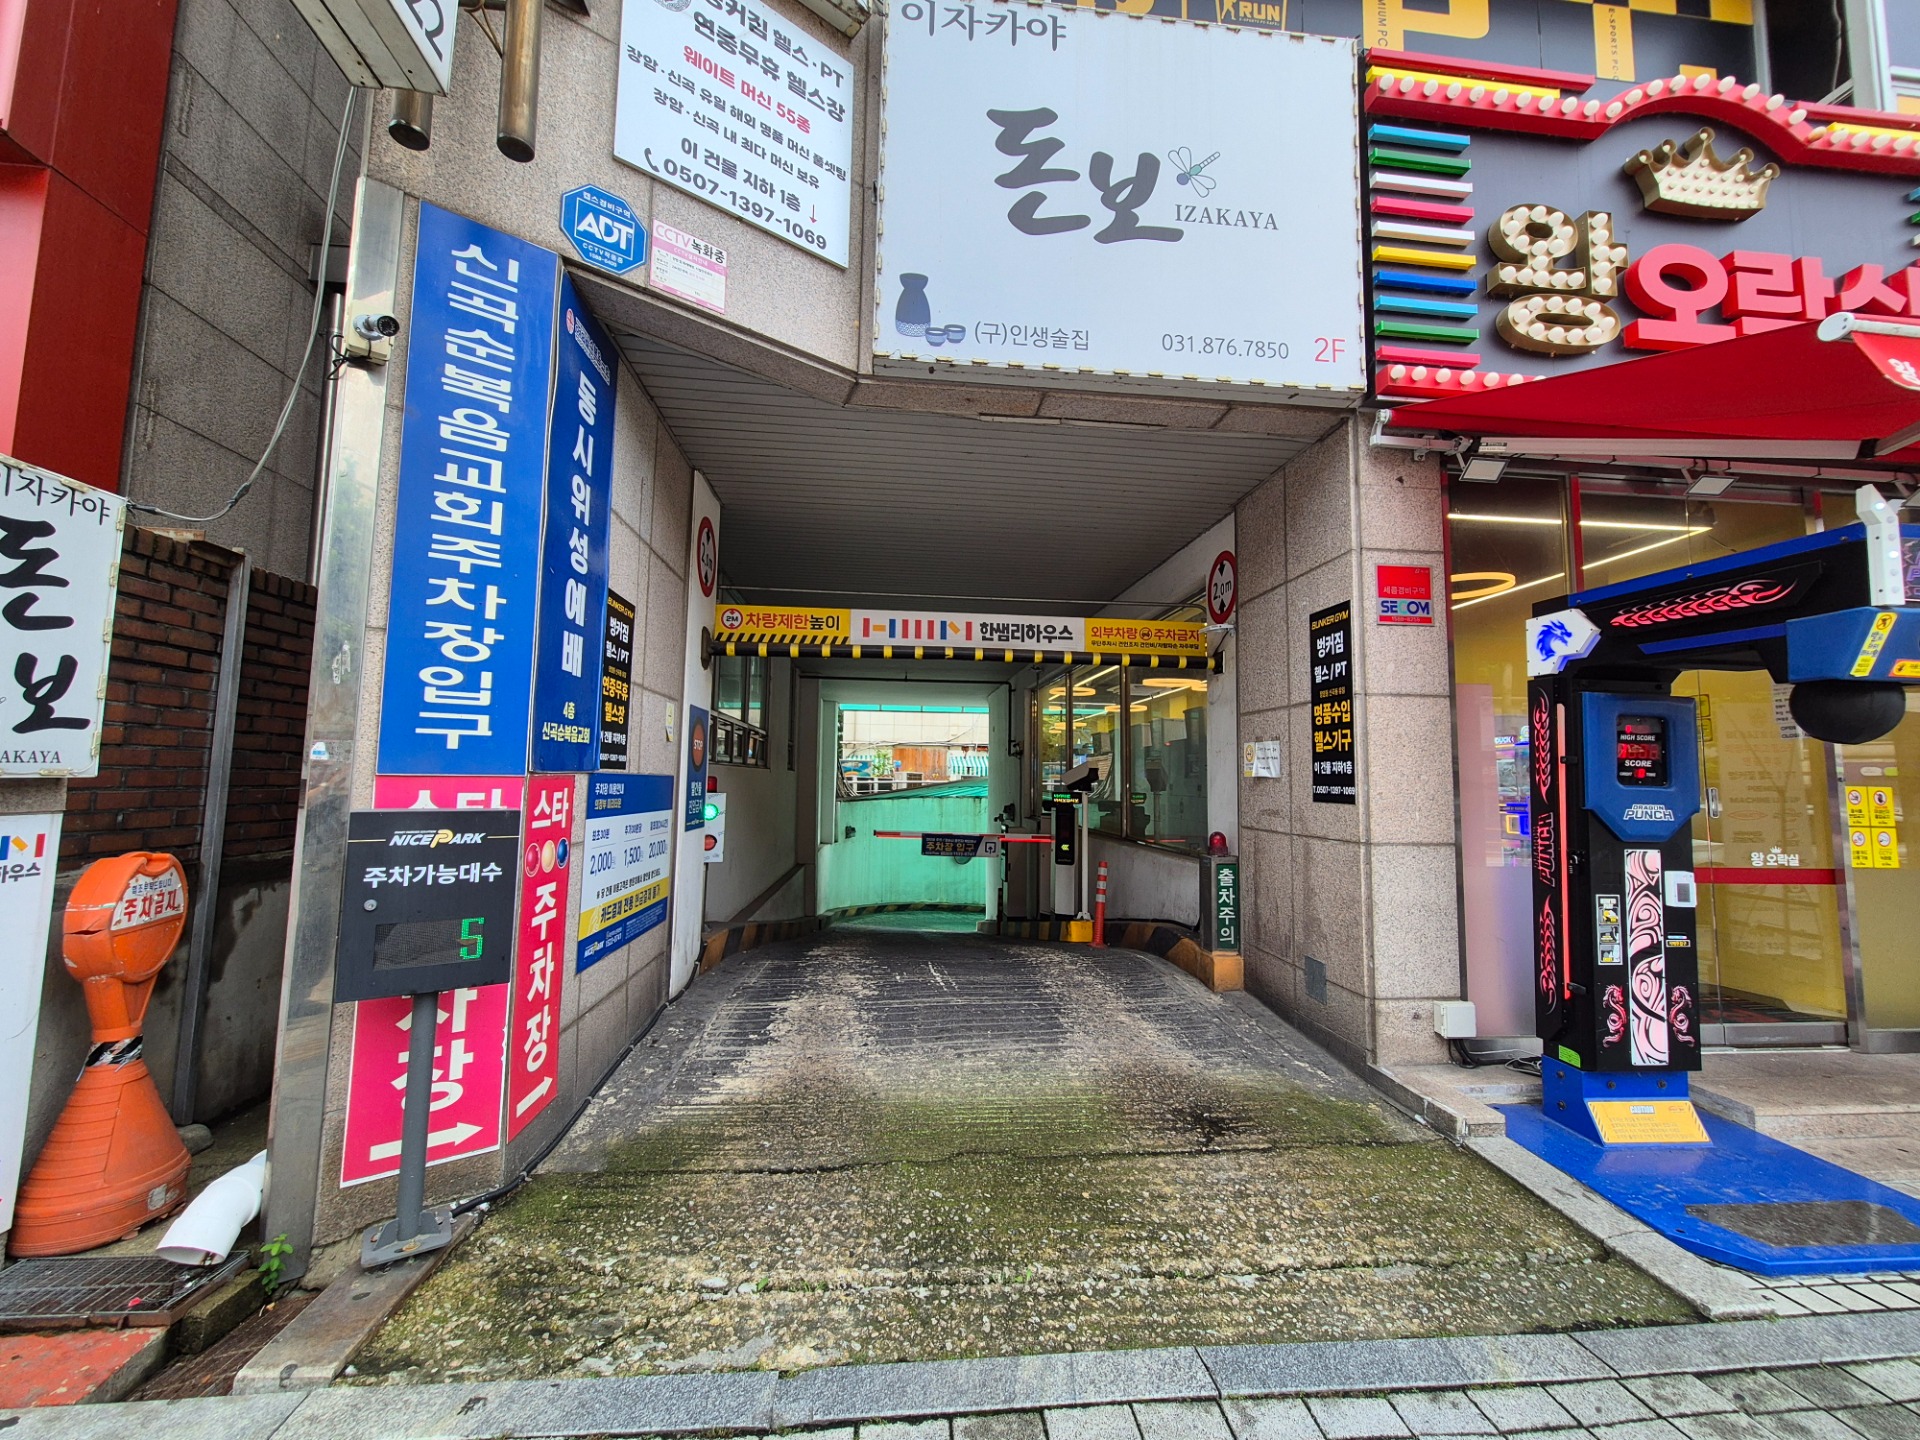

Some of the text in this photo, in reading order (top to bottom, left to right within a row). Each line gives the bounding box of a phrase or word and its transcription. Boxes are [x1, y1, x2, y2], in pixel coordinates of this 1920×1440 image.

[901, 0, 1067, 51] 이자카야
[1239, 1, 1280, 22] RUN
[1378, 30, 1388, 47] PC
[1608, 7, 1618, 56] E-SPORTS
[693, 11, 845, 122] 연중무휴 헬스장
[773, 29, 809, 67] 헬스
[820, 61, 844, 88] PT
[683, 45, 811, 134] 웨이트 머신 55종
[626, 44, 847, 182] 장암 신곡 유일 해외 명품 머신 풀셋팅
[653, 87, 820, 189] 장암 신곡 내 최다 머신 보유
[680, 137, 801, 212] 이 건물 지하 1층
[985, 106, 1185, 245] 돈보
[582, 190, 632, 219] 캡스경비구역
[663, 158, 827, 250] 0507-1397-1069
[1174, 203, 1279, 232] IZAKAYA
[577, 211, 633, 251] ADT
[1487, 203, 1628, 356] 왕
[974, 322, 1090, 352] (구)인생술집
[1161, 332, 1347, 364] 031.876.7850 2F
[414, 243, 522, 751] 신곡순복음교회주차장입구
[1213, 580, 1232, 601] 2.0m
[745, 613, 840, 631] 차량제한높이
[1311, 609, 1349, 631] BUNKER GYM
[1380, 600, 1430, 615] SECOM
[609, 616, 630, 644] 벙커짐
[1090, 626, 1200, 642] 외부차량 주차금지
[1316, 630, 1344, 659] 벙커짐
[602, 676, 629, 702] 연중무휴
[562, 701, 576, 720] 4층
[605, 701, 626, 725] 헬스장
[1313, 699, 1352, 726] 명품수입
[542, 721, 591, 745] 신곡순복음교회
[1313, 728, 1353, 753] 헬스기구
[1313, 761, 1353, 775] 이 건물 지하1층
[595, 782, 609, 796] 주차장
[531, 785, 570, 832] 스타
[1623, 809, 1675, 821] PUNCH
[926, 841, 975, 852] 주차장 입구
[1751, 852, 1800, 867] 왕 오락실
[362, 862, 503, 889] 주차가능대수
[123, 888, 179, 923] 주차금지
[600, 900, 623, 924] 카드결제
[623, 895, 634, 914] 전용
[1217, 868, 1236, 945] 출차주의
[458, 917, 485, 960] 5
[522, 880, 558, 1075] 주차장
